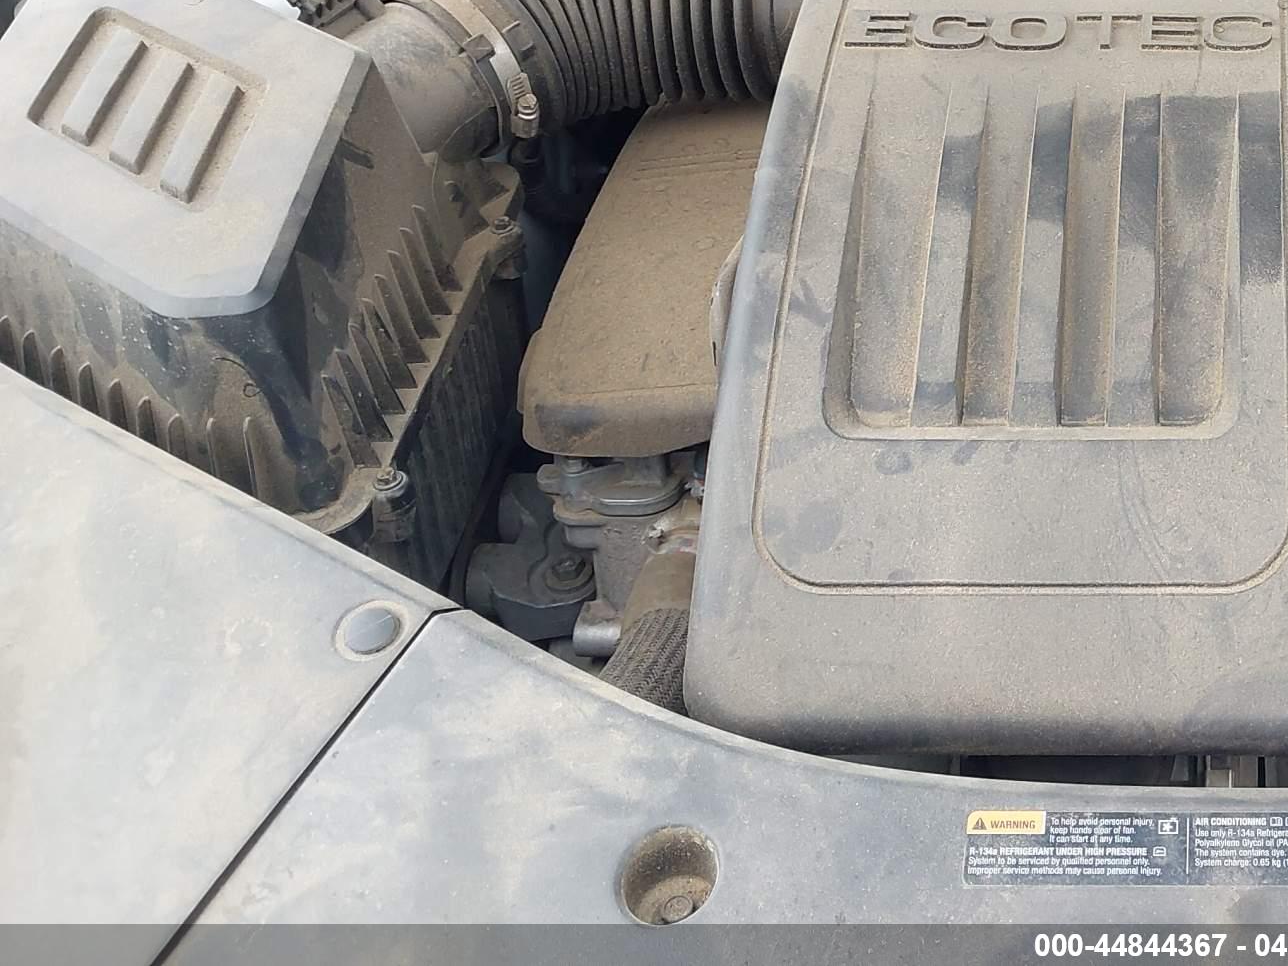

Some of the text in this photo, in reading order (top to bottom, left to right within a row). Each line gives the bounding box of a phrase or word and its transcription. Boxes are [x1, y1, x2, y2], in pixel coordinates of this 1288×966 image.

[843, 9, 1274, 52] ECOTEC
[990, 820, 1036, 829] WARNING
[1061, 818, 1077, 827] help
[1099, 818, 1131, 827] personal
[1195, 817, 1267, 826] AIR CONDITIONING
[1050, 826, 1068, 835] keep
[1113, 826, 1122, 834] of
[1123, 826, 1136, 834] fan.
[1195, 829, 1209, 837] Use
[1211, 829, 1225, 838] only
[1227, 829, 1255, 837] R-134a
[1071, 835, 1088, 843] start
[1099, 836, 1112, 844] any
[1115, 835, 1133, 843] time.
[1195, 839, 1240, 848] Polyalkylene
[1242, 839, 1264, 847] Glycol
[969, 847, 1147, 856] R-134a REFRIGERANT UNDER HIGH PRESSURE
[1195, 848, 1287, 858] The system contains dye.
[968, 856, 1150, 866] System to be serviced by qualified personnel only.
[1195, 858, 1222, 867] System
[1224, 858, 1250, 867] charge:
[1253, 858, 1270, 866] 0.65
[1272, 858, 1281, 867] kg
[1003, 866, 1029, 874] service
[1031, 866, 1063, 874] methods
[1065, 867, 1081, 876] may
[1107, 866, 1138, 876] personal
